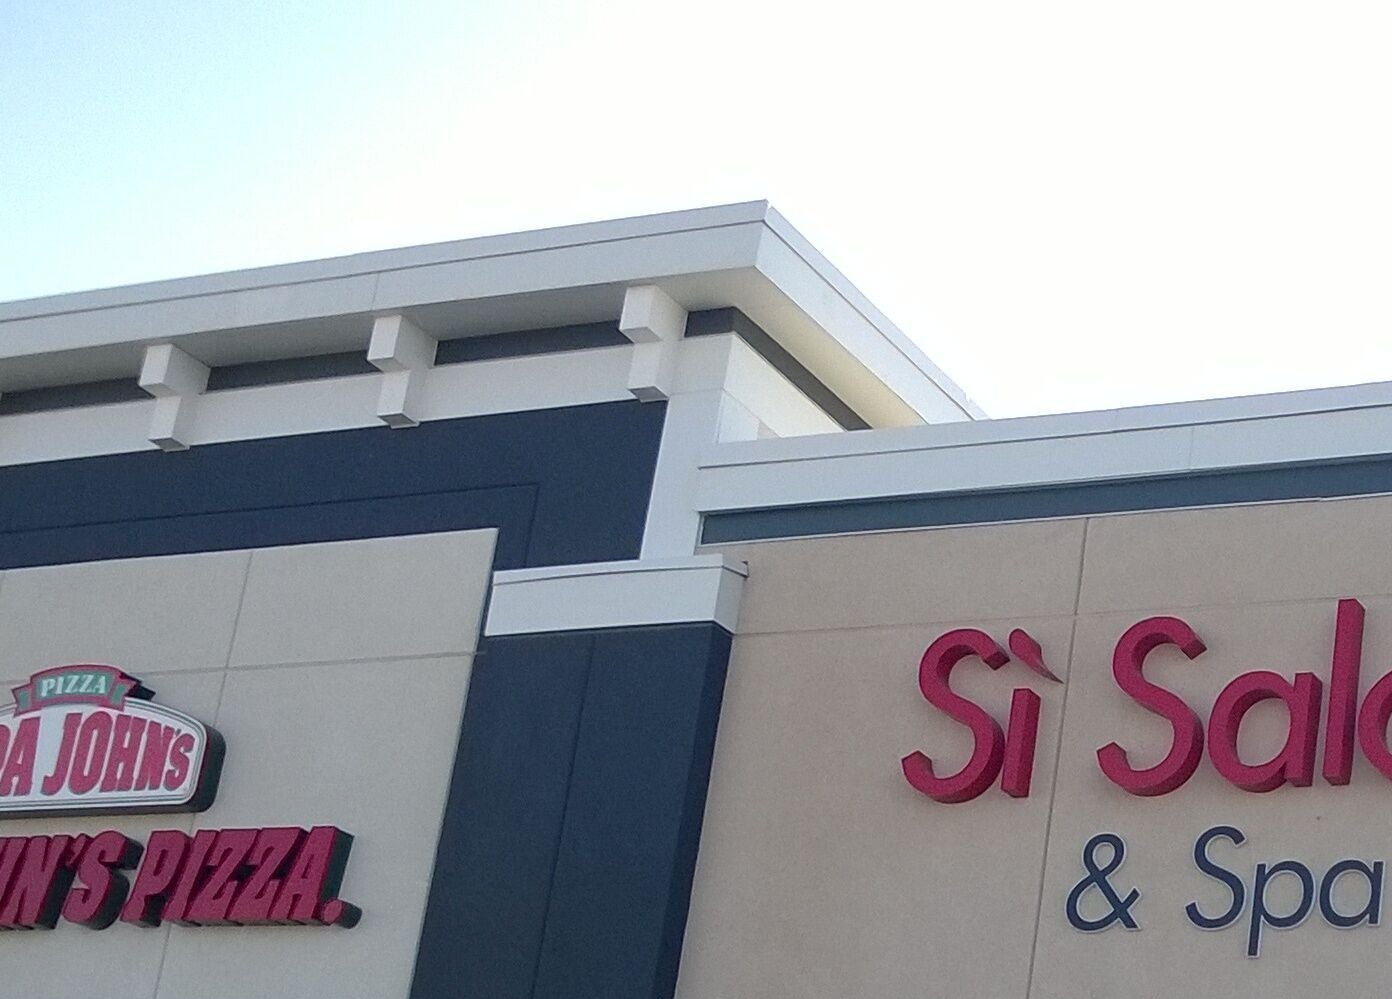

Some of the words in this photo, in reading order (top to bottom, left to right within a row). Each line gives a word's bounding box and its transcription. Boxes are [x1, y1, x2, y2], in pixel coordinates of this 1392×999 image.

[40, 674, 107, 697] PIZZA
[40, 710, 196, 796] JOHN'S
[120, 825, 361, 930] PIZZA.
[1064, 832, 1143, 932] &
[1184, 824, 1385, 959] Spa
